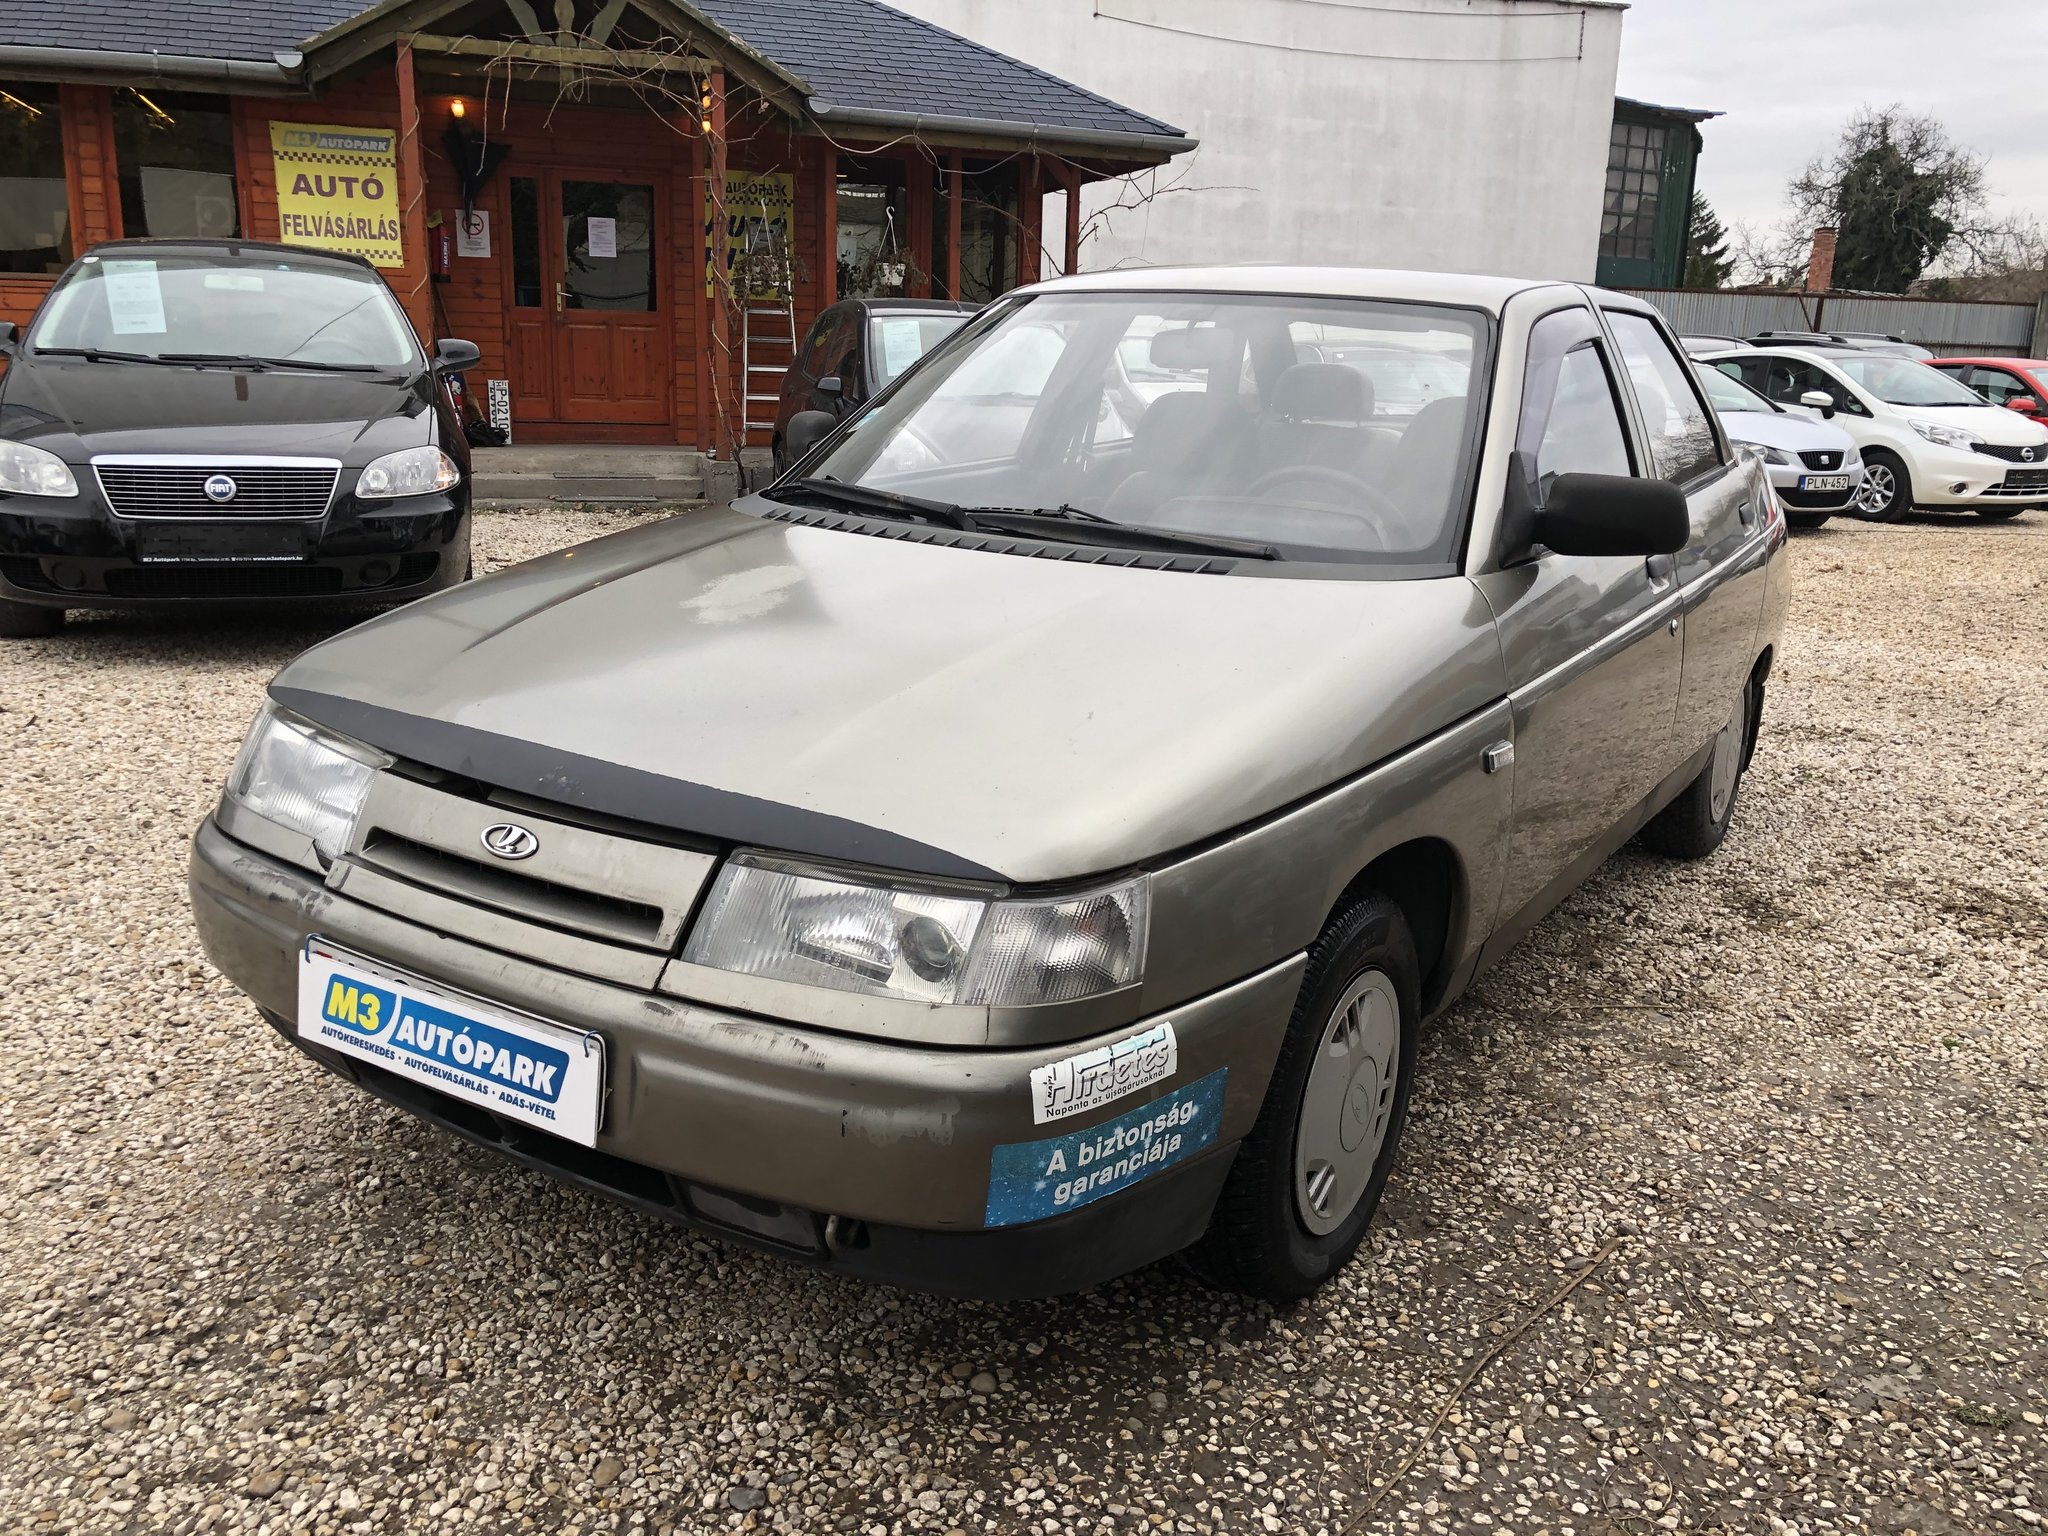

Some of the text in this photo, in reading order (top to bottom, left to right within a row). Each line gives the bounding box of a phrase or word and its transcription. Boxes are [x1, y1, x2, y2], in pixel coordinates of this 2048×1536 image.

[318, 137, 387, 151] AUTÓPARK
[292, 173, 384, 200] AUTÓ
[283, 211, 398, 241] FELVÁSÁRLÁS
[211, 484, 230, 493] FIAT
[1807, 478, 1847, 488] PLN-452
[327, 982, 558, 1096] M3 AUTÓPARK
[320, 1025, 556, 1121] AUTÓKERESKEDÉS AUTÓFELVÁSÁRLÁS ADÁS-VÉTEL
[1046, 1066, 1165, 1118] Naponta az újságárusoknál
[1045, 1100, 1194, 1176] A biztonság
[1053, 1133, 1183, 1206] garanciája
